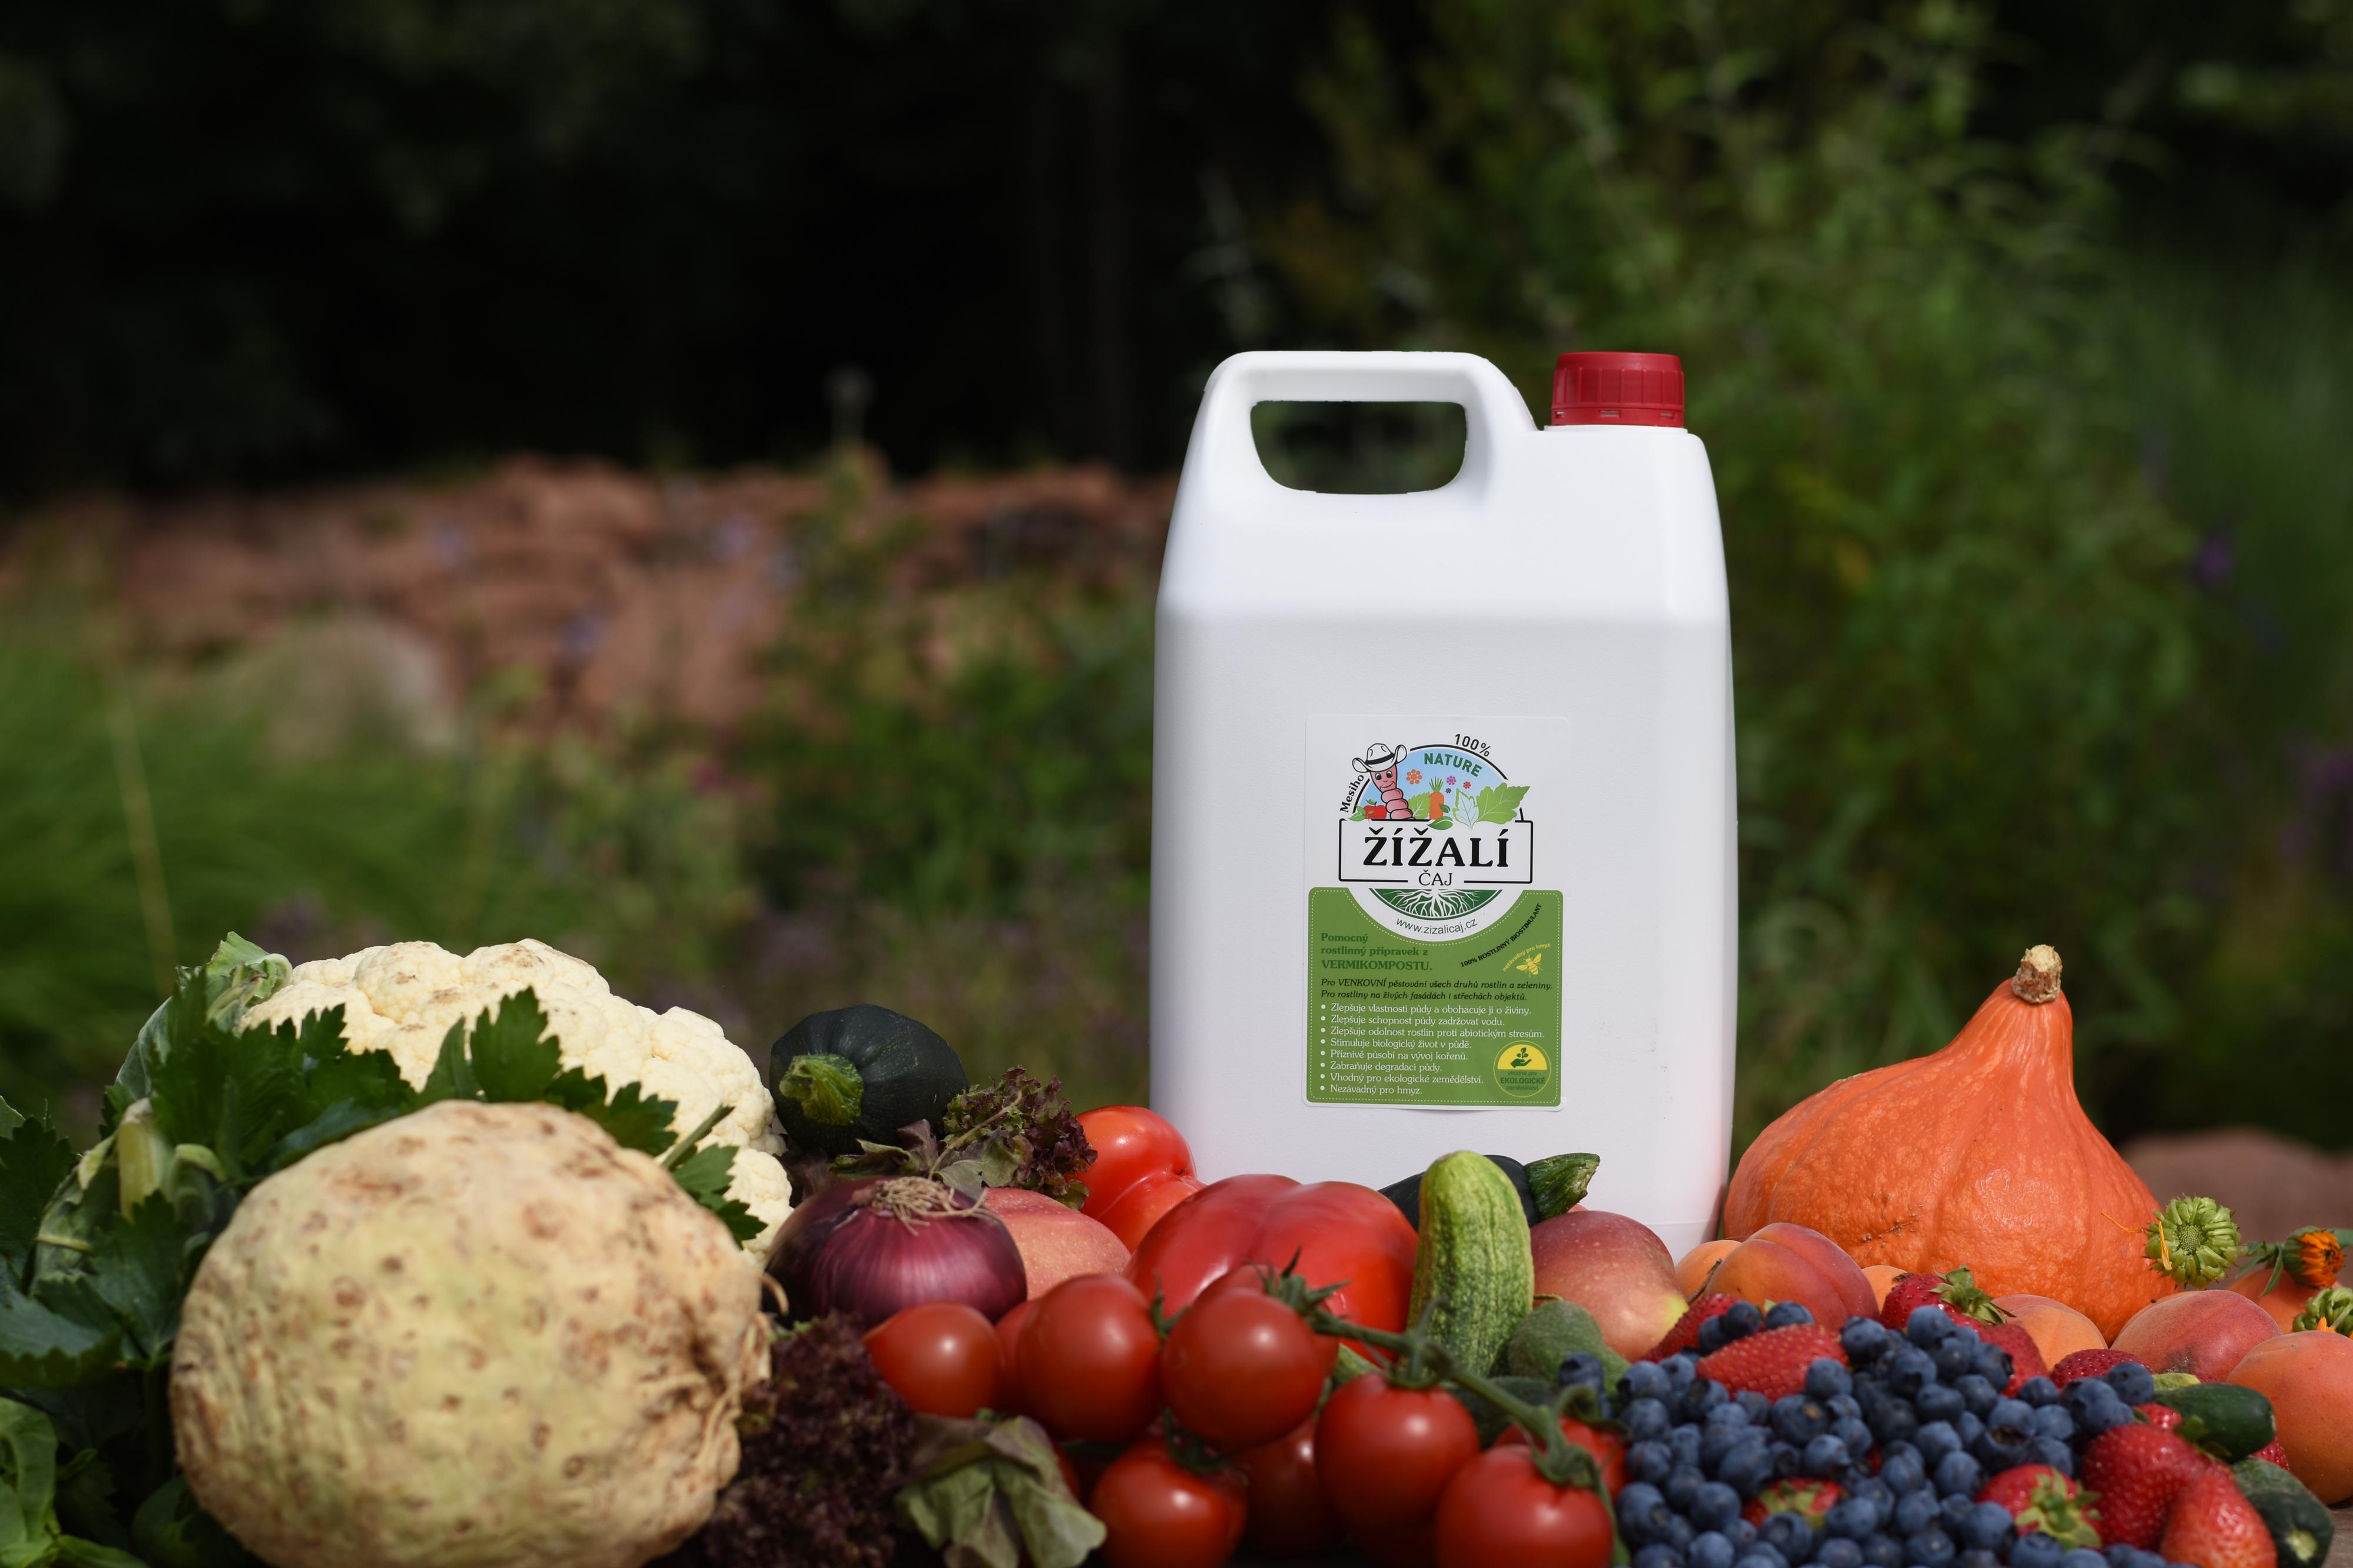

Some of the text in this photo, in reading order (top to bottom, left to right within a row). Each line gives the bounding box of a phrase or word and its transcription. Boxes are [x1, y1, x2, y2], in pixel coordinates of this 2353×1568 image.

[1455, 733, 1491, 757] 100%
[1424, 753, 1482, 777] NATURE
[1340, 774, 1364, 813] Mesiho
[1363, 826, 1509, 867] ŽÍŽALÍ
[1418, 869, 1452, 886] ČAJ
[1396, 918, 1478, 935] www.zizalicaj.cz
[1321, 933, 1368, 943] Pomocný
[1460, 903, 1542, 968] 100% ROSTLINNÝ BIOSTIMULANT
[1321, 946, 1366, 956] rostlinný
[1369, 947, 1419, 957] přípravek
[1322, 960, 1432, 970] VERMIKOMPOSTU.
[1502, 950, 1525, 972] nezávadný
[1338, 978, 1387, 986] VENKOVNÍ
[1517, 982, 1552, 990] zeleniny.
[1338, 991, 1368, 999] rostliny
[1383, 991, 1408, 1000] živých
[1410, 991, 1445, 999] fasádách
[1495, 993, 1527, 1002] objektů.
[1331, 1003, 1366, 1014] Zlepšuje
[1369, 1004, 1408, 1013] vlastnosti
[1411, 1005, 1431, 1015] půdy
[1442, 1005, 1486, 1015] obohacuje
[1488, 1006, 1493, 1016] ji
[1505, 1006, 1531, 1016] živiny.
[1331, 1015, 1505, 1026] Zlepšuje schopnost půdy zadržovat vodu.
[1331, 1026, 1365, 1037] Zlepšuje
[1368, 1027, 1405, 1036] odolnost
[1408, 1028, 1434, 1036] rostlin
[1437, 1029, 1457, 1038] proti
[1460, 1029, 1506, 1039] abiotickým
[1331, 1038, 1369, 1048] Stimuluje
[1373, 1039, 1415, 1049] biologický
[1418, 1040, 1438, 1048] život
[1448, 1040, 1472, 1049] půdě.
[1331, 1050, 1364, 1059] Příznivě
[1367, 1050, 1395, 1060] působí
[1411, 1052, 1433, 1061] vývoj
[1436, 1052, 1468, 1060] kořenů.
[1331, 1061, 1442, 1073] Zabraňuje degradaci půdy.
[1331, 1073, 1364, 1082] Vhodný
[1384, 1075, 1429, 1084] ekologické
[1432, 1075, 1484, 1083] zemědělství.
[1331, 1085, 1377, 1095] Nezávadný
[1397, 1086, 1422, 1096] hmyz.
